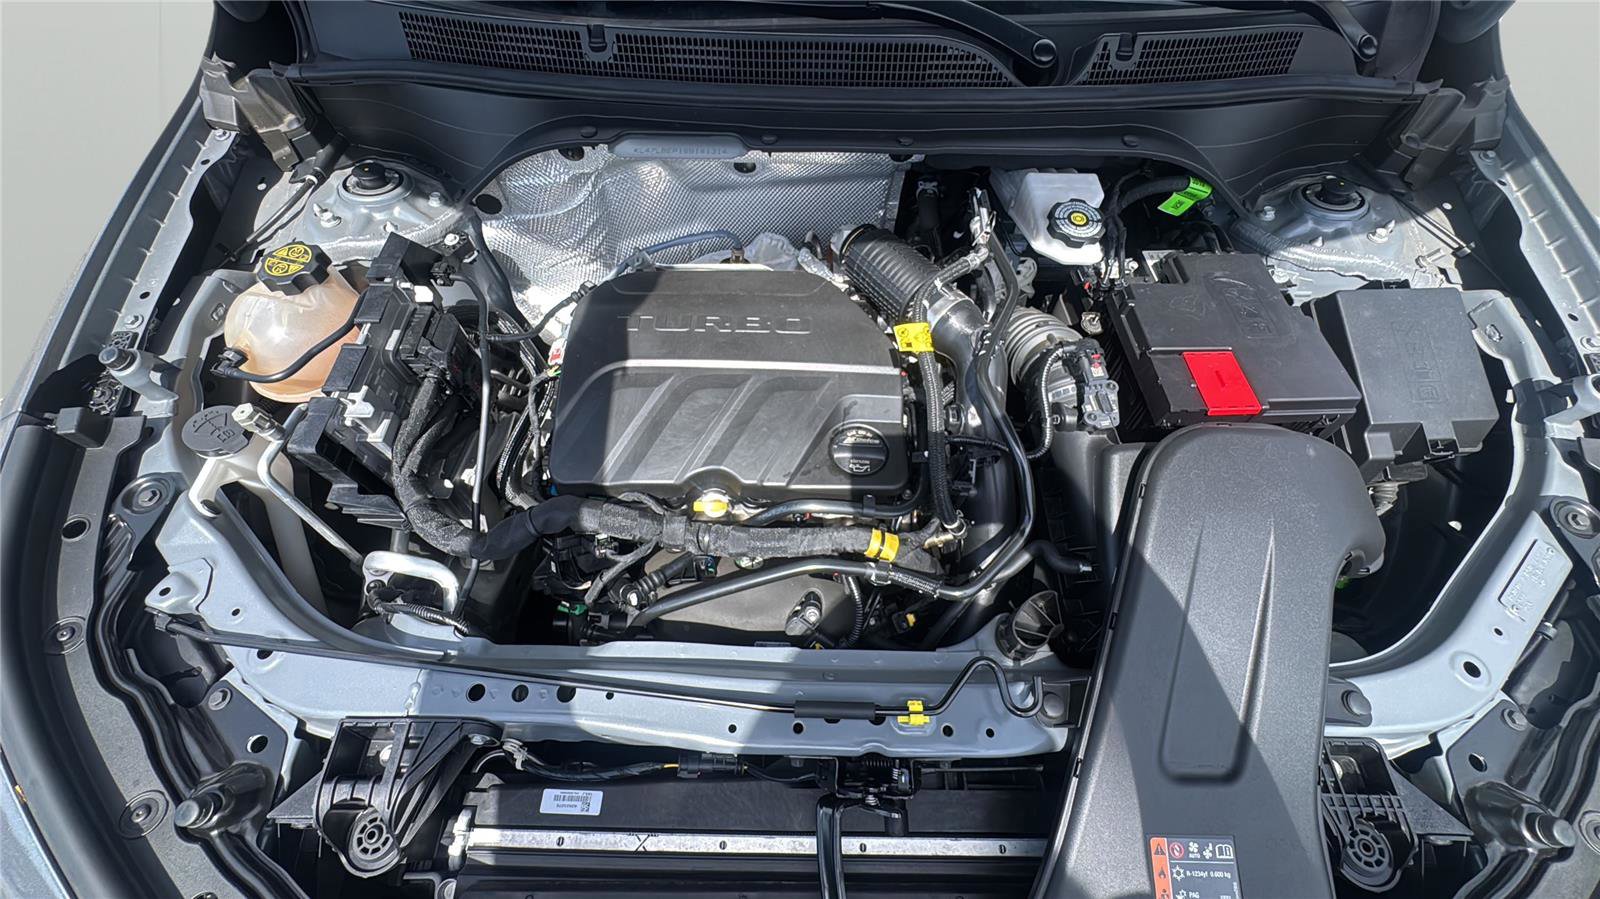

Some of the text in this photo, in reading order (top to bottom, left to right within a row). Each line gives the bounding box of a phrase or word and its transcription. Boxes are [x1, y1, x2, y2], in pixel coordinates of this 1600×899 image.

[617, 313, 812, 334] TURBO
[1225, 871, 1231, 879] kg
[1188, 891, 1200, 899] PAG
